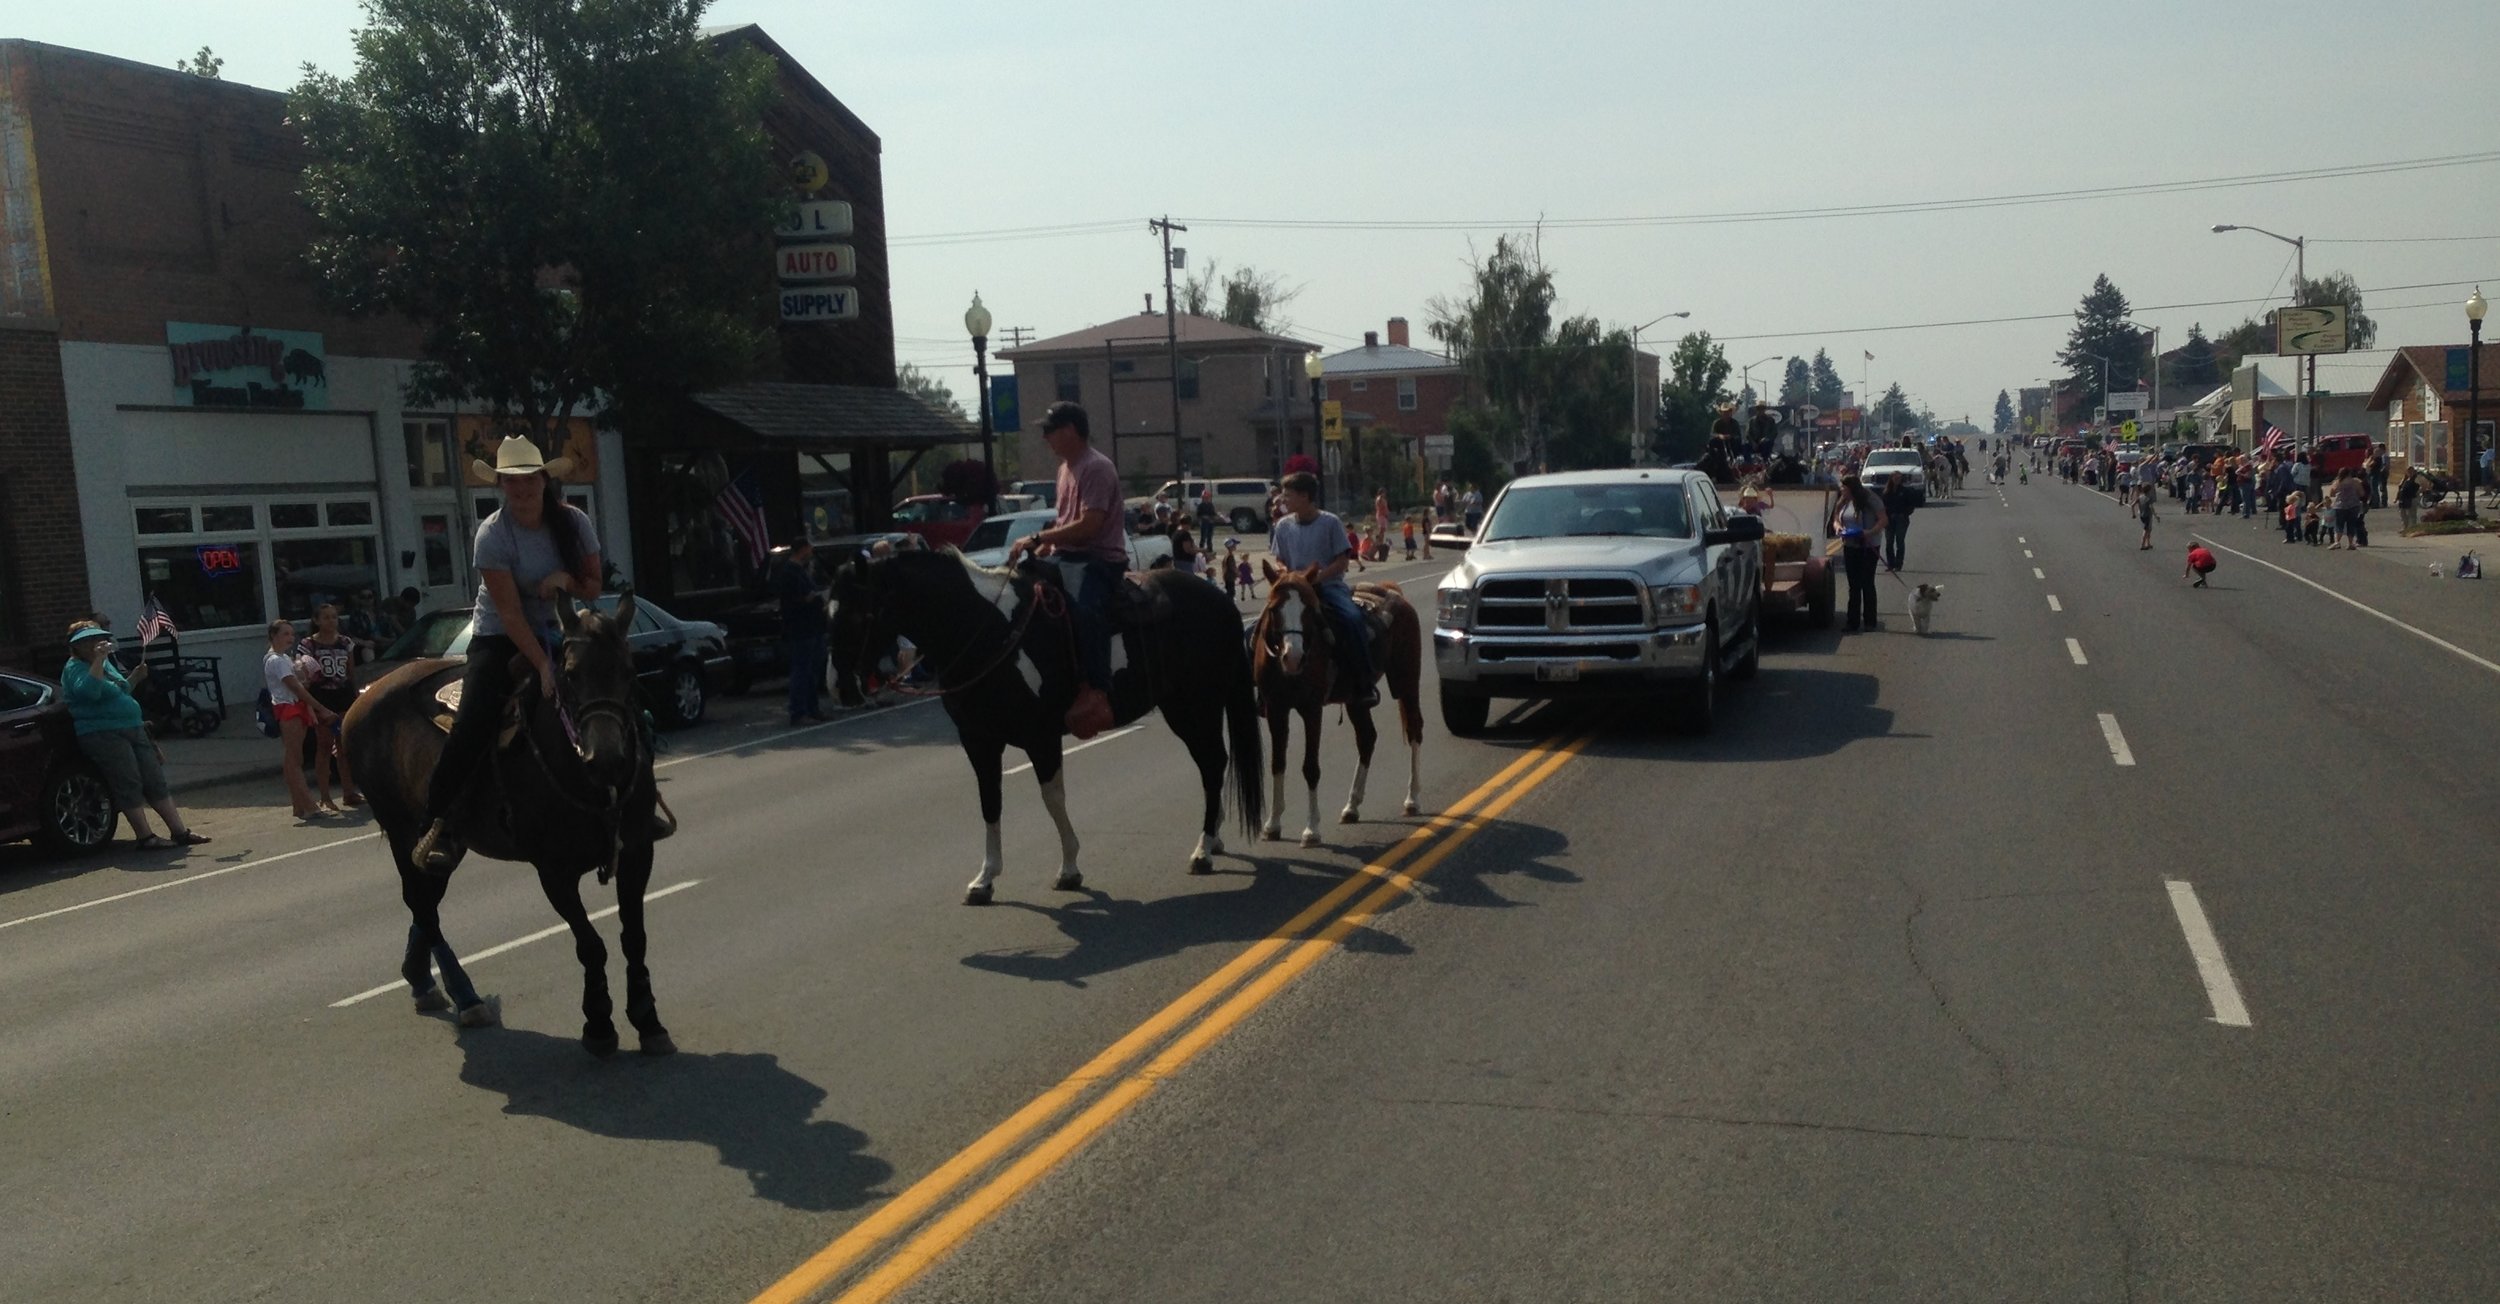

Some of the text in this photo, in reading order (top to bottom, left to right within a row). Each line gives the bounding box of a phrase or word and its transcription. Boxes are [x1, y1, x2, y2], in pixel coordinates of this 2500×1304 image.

[786, 252, 838, 273] AUTO
[783, 294, 845, 316] SUPPLY
[203, 551, 241, 570] OPEN
[320, 655, 348, 678] 85
